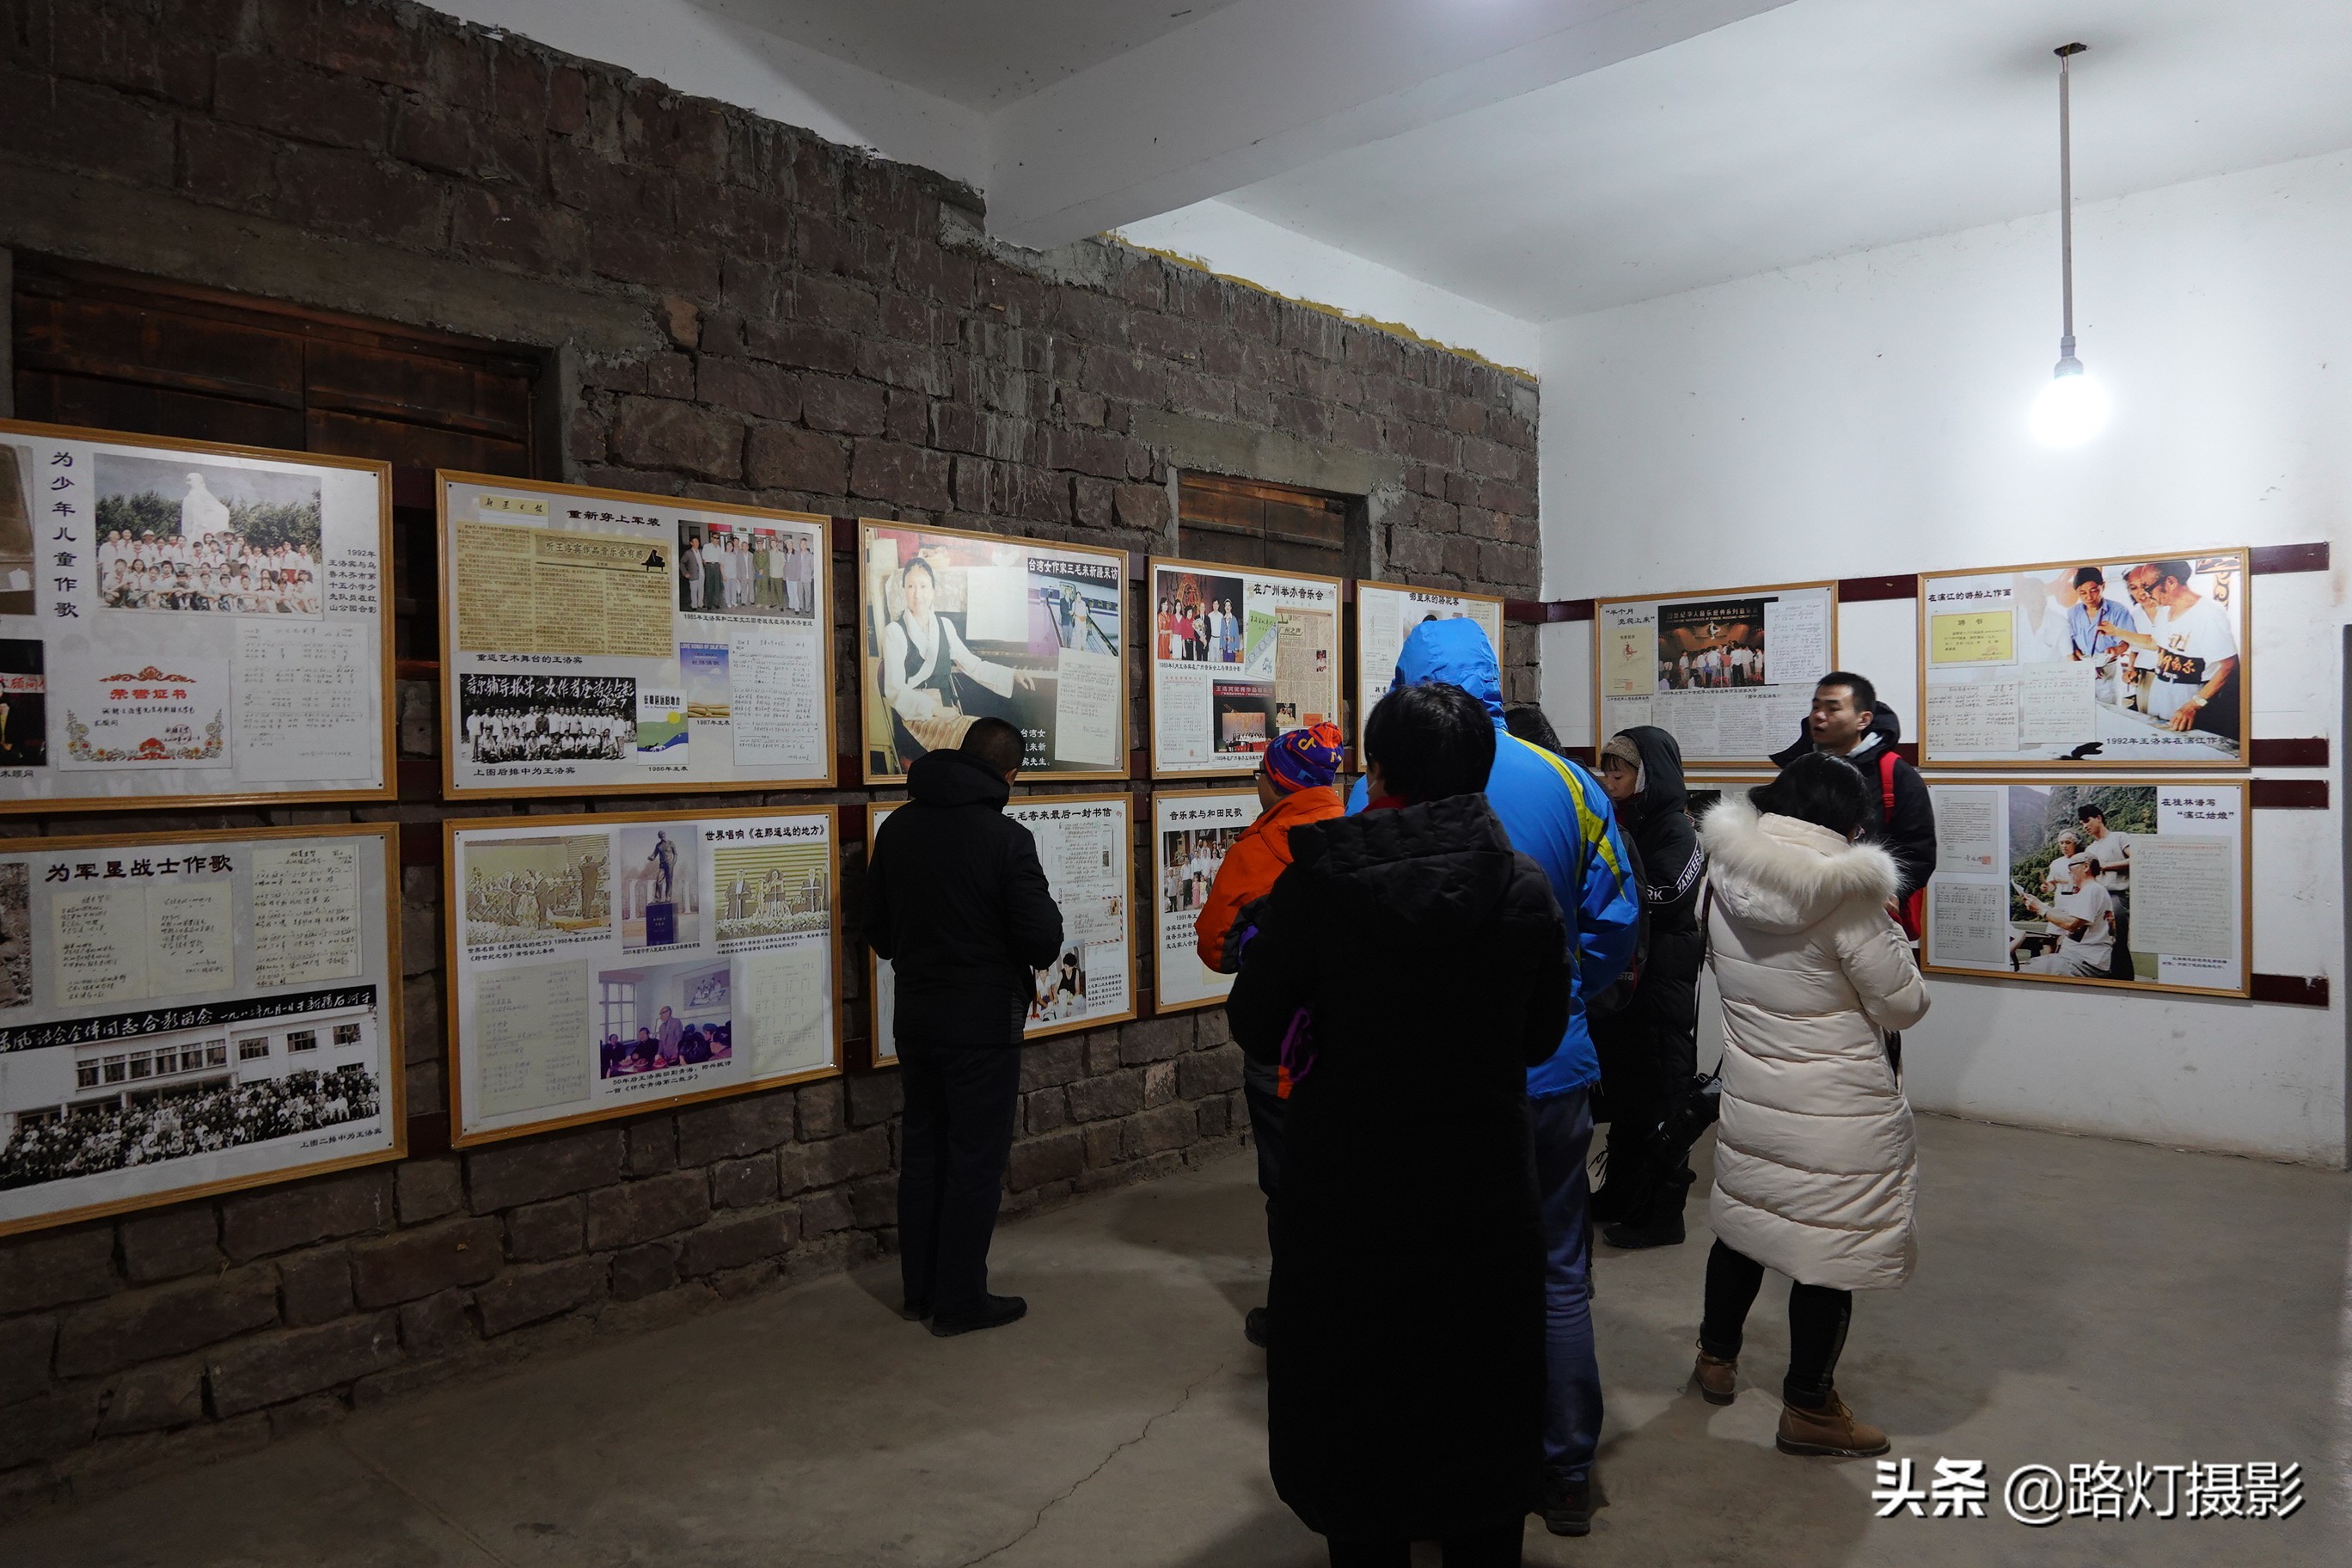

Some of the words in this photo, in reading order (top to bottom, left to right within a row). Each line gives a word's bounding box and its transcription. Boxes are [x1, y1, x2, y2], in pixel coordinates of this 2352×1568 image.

[567, 510, 661, 527] 重新穿上军装
[51, 451, 79, 618] 为少年儿童作歌
[347, 549, 377, 558] 1992年
[546, 542, 644, 559] 听王洛宾作品音乐会有感
[328, 559, 377, 569] 王洛宾与乌
[1029, 559, 1118, 580] 台湾女作家三毛来新疆采访
[328, 571, 377, 580] 鲁木齐市第
[328, 582, 377, 591] 十五小学少
[1253, 583, 1324, 601] 在广州举办音乐会
[328, 593, 377, 603] 先队员在红
[1928, 589, 2012, 602] 在漓江的游船上作画
[329, 604, 377, 614] 山公园合影
[476, 653, 584, 665] 重返艺术舞台的王洛宾
[110, 689, 187, 700] 荣誉证书
[1020, 728, 1046, 738] 台湾女
[473, 766, 576, 776] 上图后排中为王洛宾
[2161, 798, 2216, 807] 在桂林谱写
[1007, 807, 1112, 822] 三毛寄来最后一封书信
[1169, 807, 1243, 821] 音乐家与和田民歌
[2177, 811, 2234, 820] “漓江姑娘”
[705, 824, 826, 841] 世界唱响《在那遥远的地方》
[45, 854, 234, 883] 为军垦战士作歌
[1166, 923, 1196, 932] 洛宾在和田
